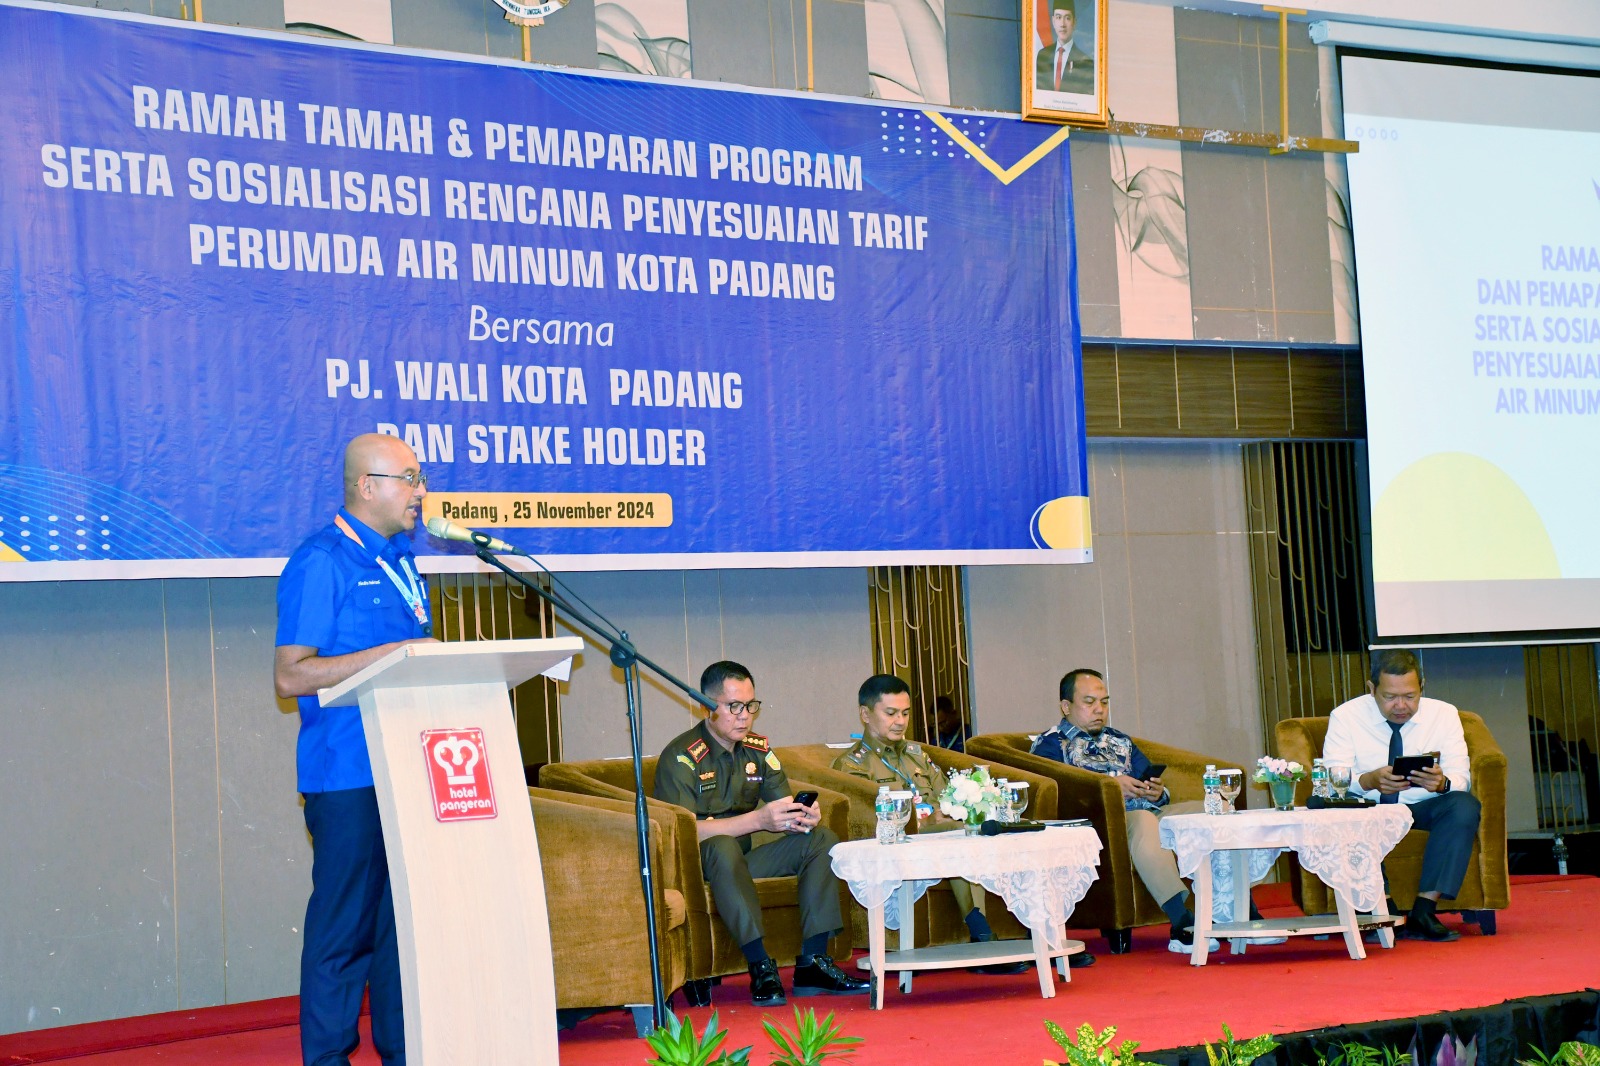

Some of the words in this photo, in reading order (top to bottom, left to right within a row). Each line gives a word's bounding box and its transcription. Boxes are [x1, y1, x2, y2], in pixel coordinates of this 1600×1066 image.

[133, 85, 286, 141] RAMAH
[299, 103, 433, 154] TAMAH
[448, 119, 473, 157] &
[485, 122, 697, 177] PEMAPARAN
[709, 144, 862, 191] PROGRAM
[41, 144, 173, 197] SERTA
[188, 158, 430, 216] SOSIALISASI
[445, 180, 611, 229] RENCANA
[623, 195, 839, 245] PENYESUAIAN
[849, 212, 928, 250] TARIF
[190, 224, 384, 275] PERUMDA
[397, 239, 458, 280] AIR
[472, 243, 604, 289] MINUM
[617, 253, 698, 293] KOTA
[709, 259, 835, 301] PADANG
[1477, 278, 1521, 306] DAN
[469, 304, 614, 347] Bersama
[1474, 314, 1538, 342] SERTA
[1472, 350, 1600, 379] PENYESUAIA
[326, 358, 382, 399] PJ.
[395, 361, 487, 402] WALI
[502, 365, 587, 405] KOTA
[610, 369, 742, 408] PADANG
[1495, 387, 1530, 414] AIR
[1534, 388, 1600, 415] MINUM
[468, 425, 571, 464] STAKE
[584, 428, 706, 466] HOLDER
[442, 501, 498, 522] Padang
[513, 501, 532, 519] 25
[537, 501, 612, 519] November
[617, 501, 654, 519] 2024
[440, 799, 491, 813] pangeran
[449, 786, 477, 798] hotel
